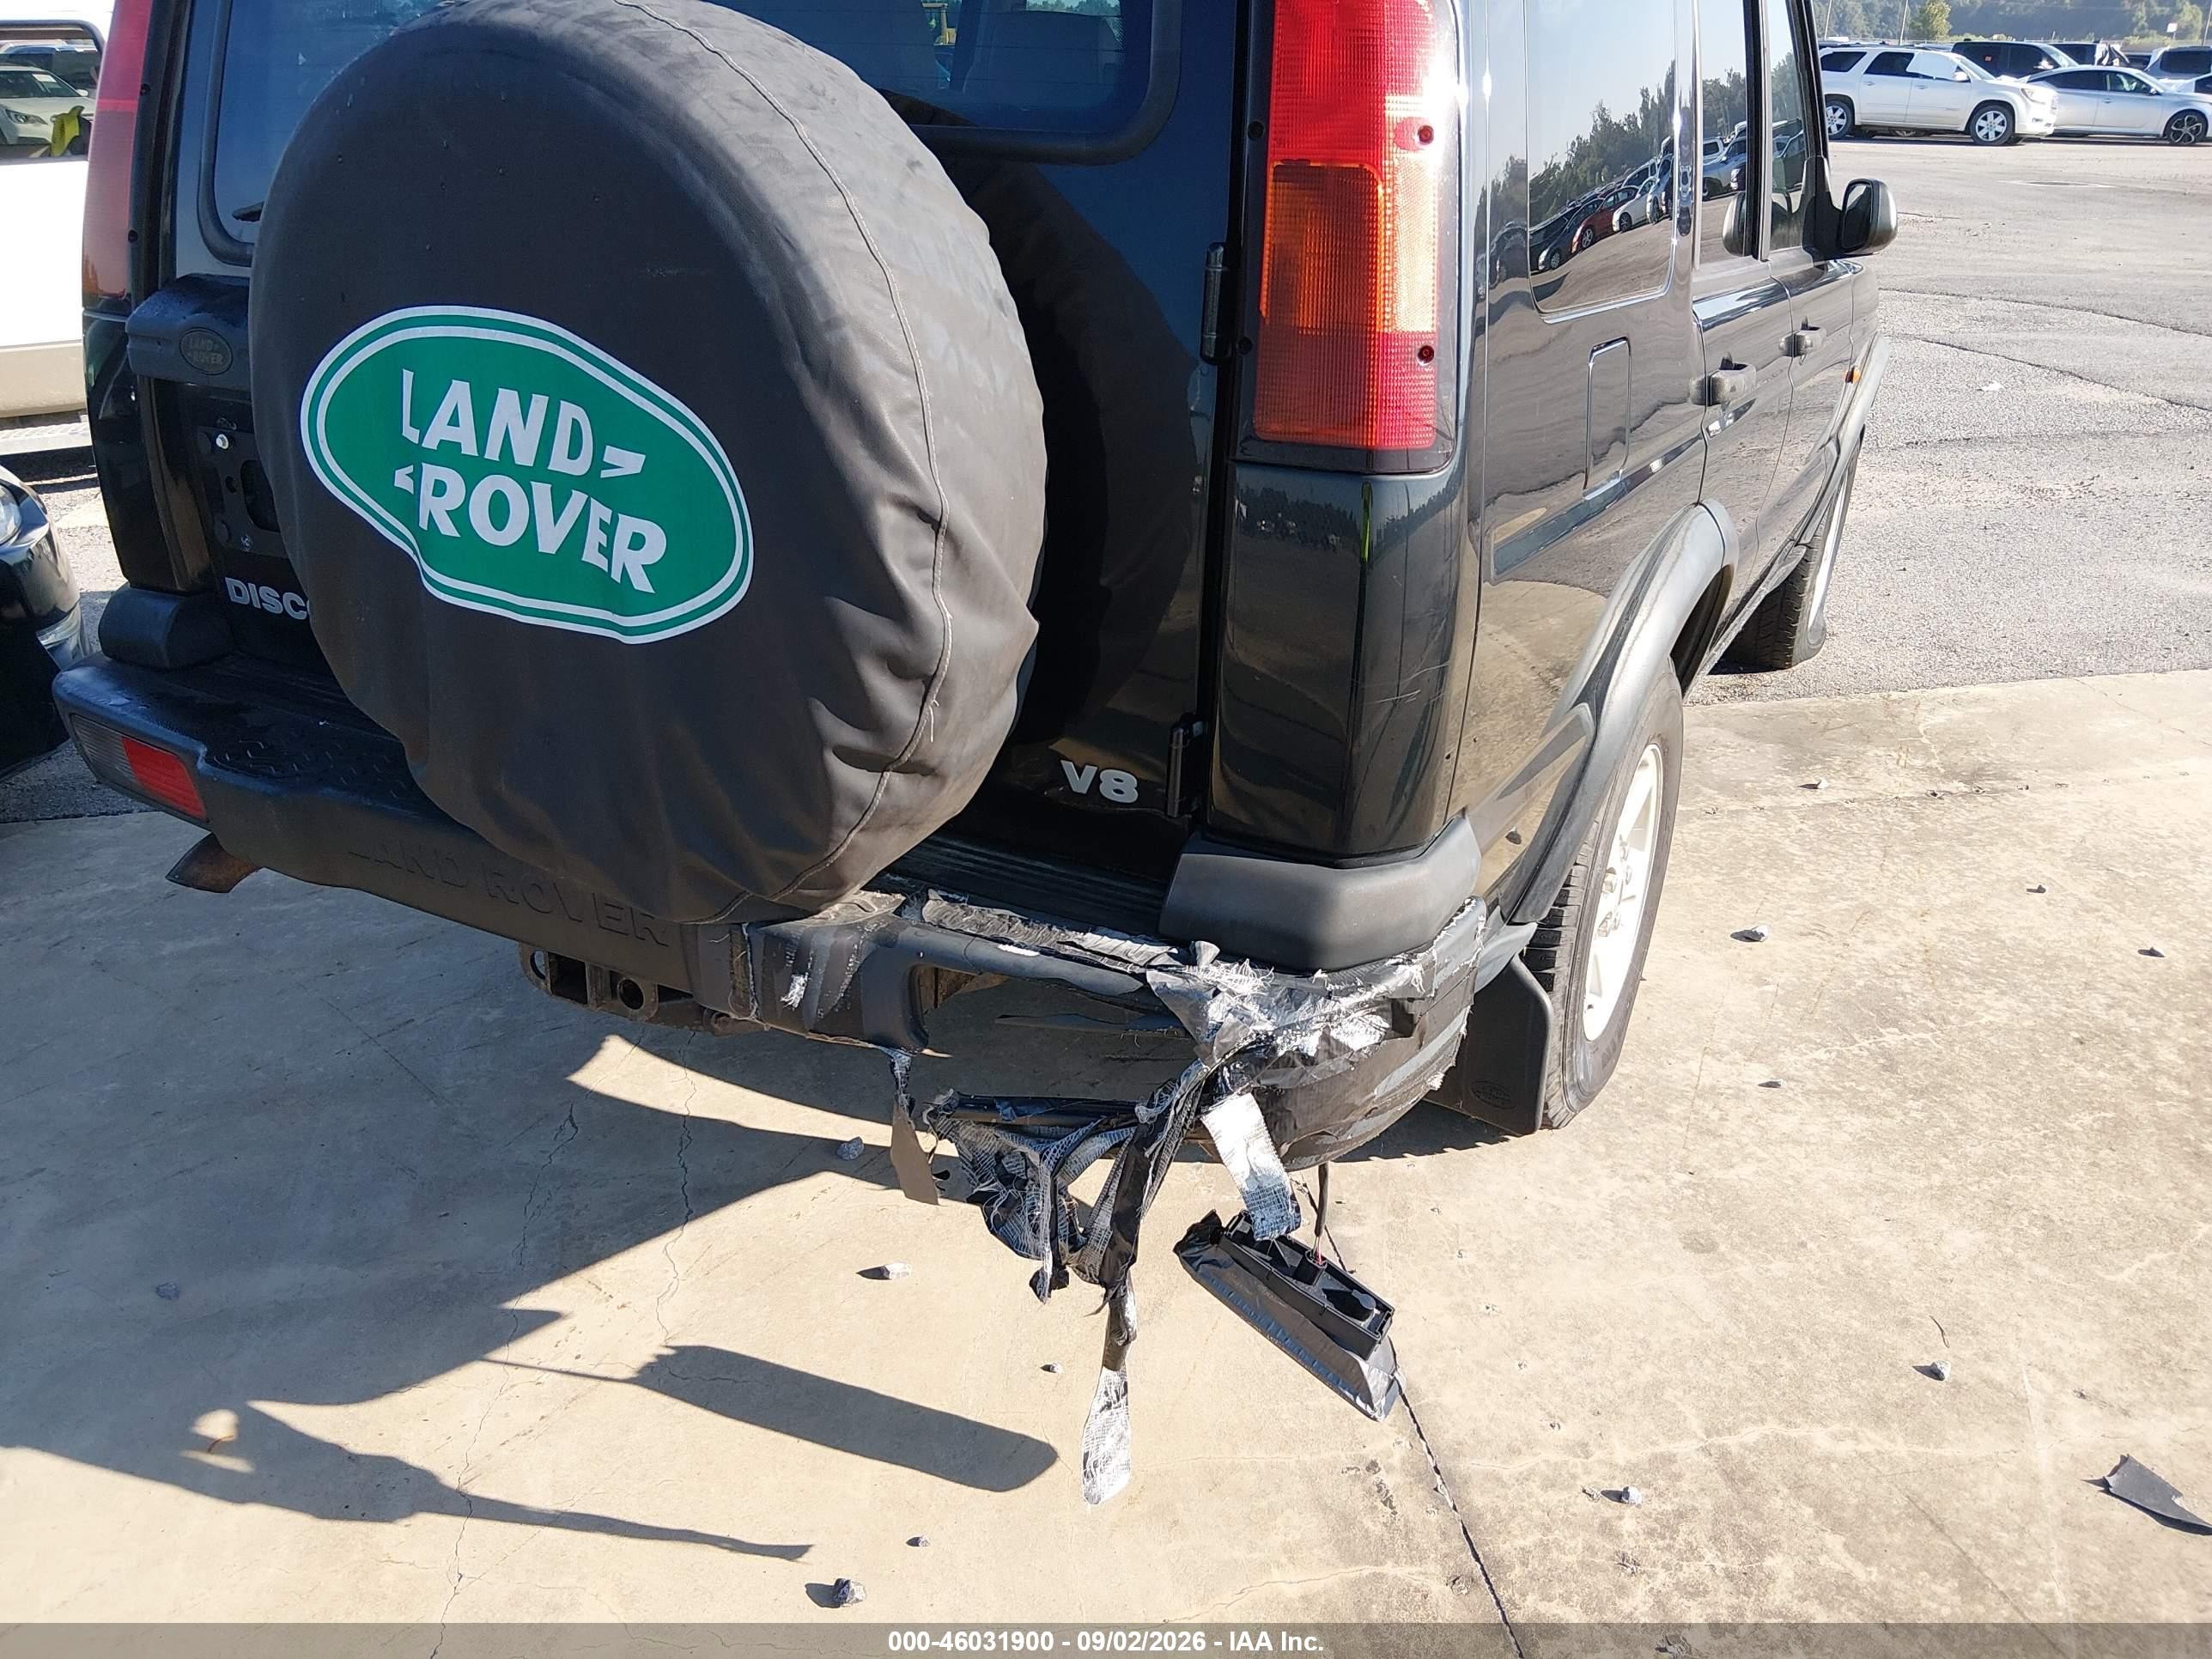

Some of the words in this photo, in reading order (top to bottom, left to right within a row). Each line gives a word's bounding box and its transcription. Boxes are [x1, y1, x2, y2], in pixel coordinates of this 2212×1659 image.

[402, 368, 593, 476] LAND
[418, 461, 667, 594] ROVER
[224, 576, 310, 620] DISC
[1060, 759, 1139, 804] V8
[481, 860, 670, 949] ROVER
